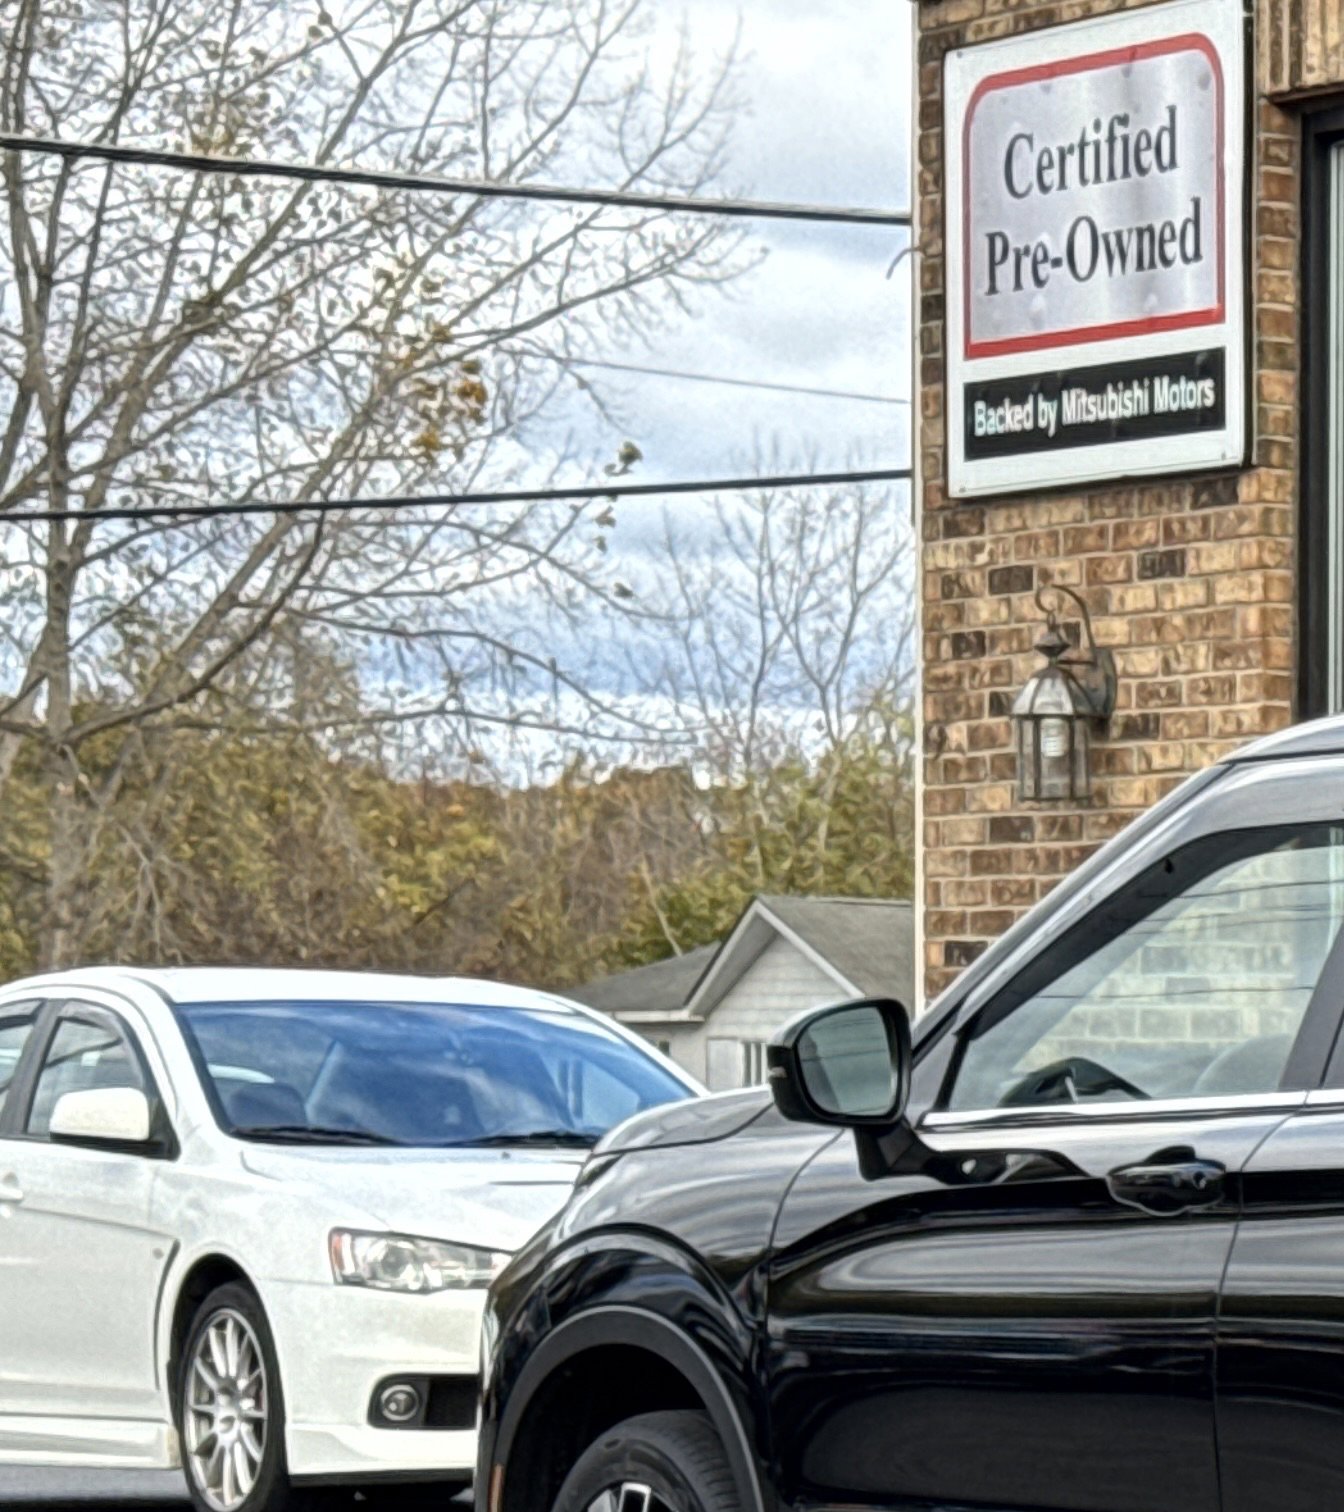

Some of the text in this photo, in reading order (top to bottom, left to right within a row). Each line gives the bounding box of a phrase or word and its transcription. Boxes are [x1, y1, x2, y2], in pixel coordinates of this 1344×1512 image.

[1003, 104, 1180, 199] Certified
[984, 196, 1203, 296] Pre-Owned
[974, 376, 1216, 438] Backed by Mitsubishi Motors
